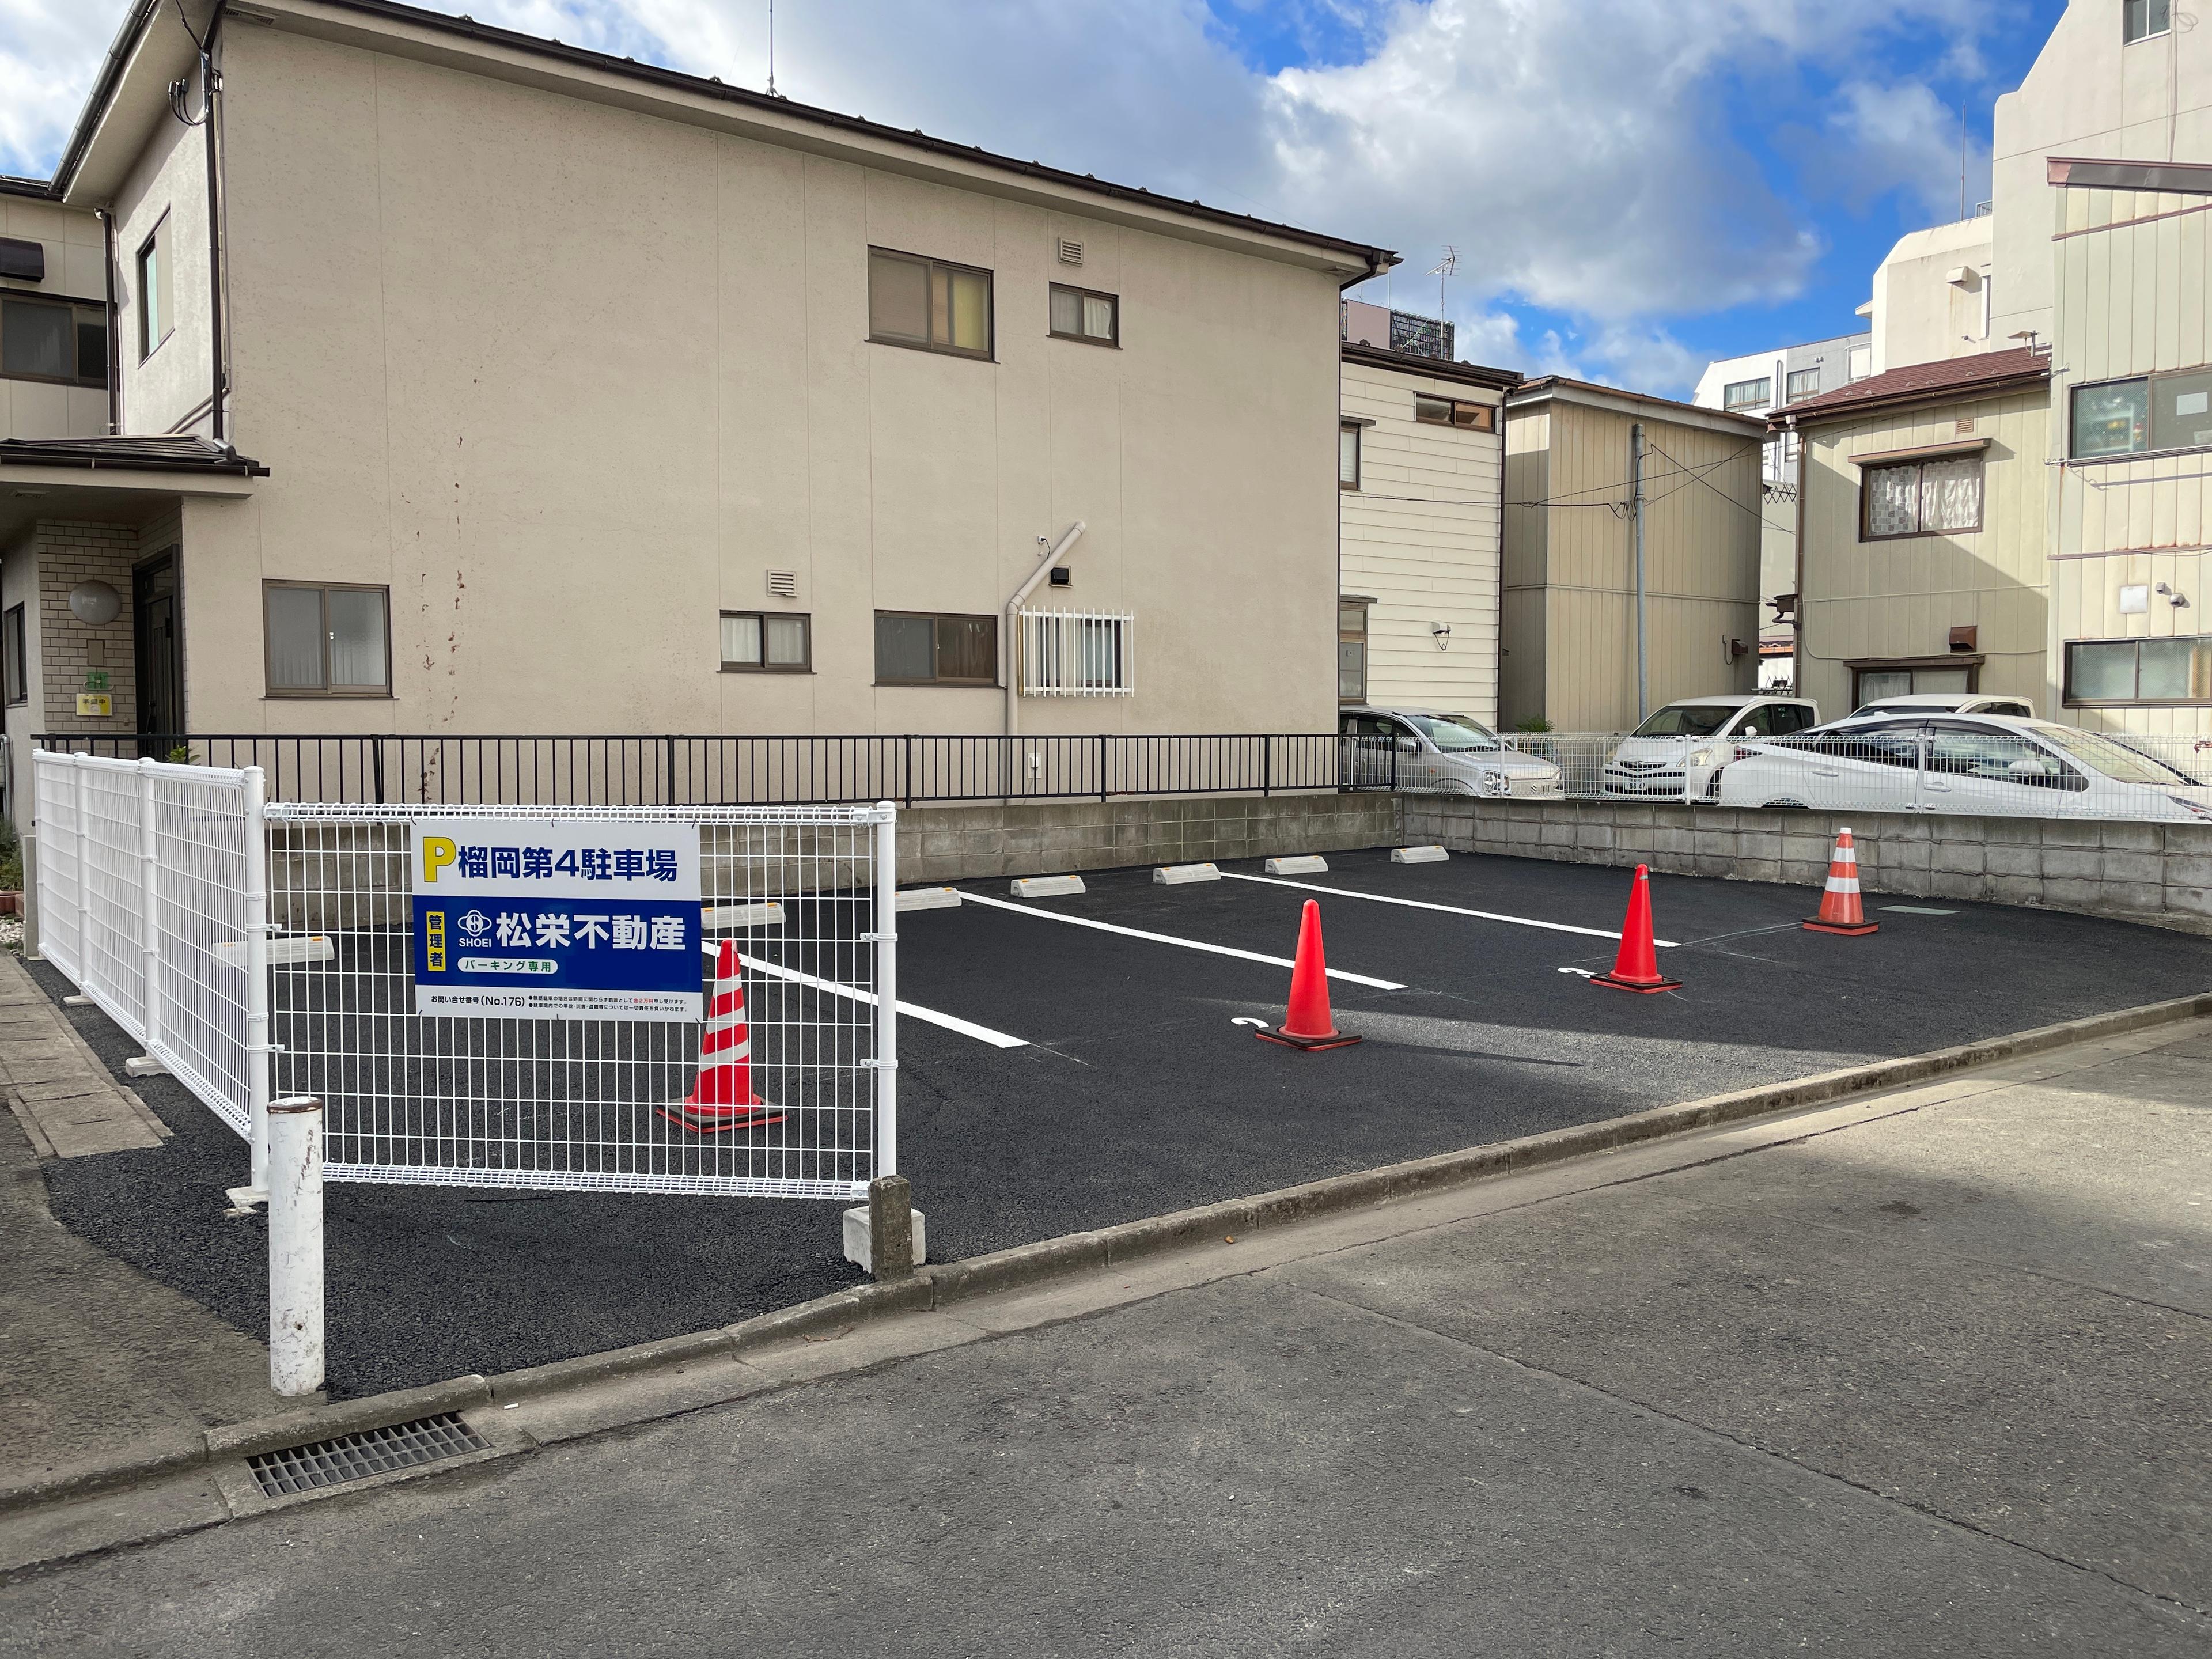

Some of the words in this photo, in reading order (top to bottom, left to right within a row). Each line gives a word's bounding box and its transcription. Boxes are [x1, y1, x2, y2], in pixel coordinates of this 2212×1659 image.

[422, 836, 456, 882] P
[458, 846, 678, 882] 榴岡第4駐車場
[429, 915, 443, 967] 管理者
[459, 938, 492, 948] SHOEI
[496, 912, 686, 950] 松栄不動産
[464, 960, 552, 973] パーキング専用
